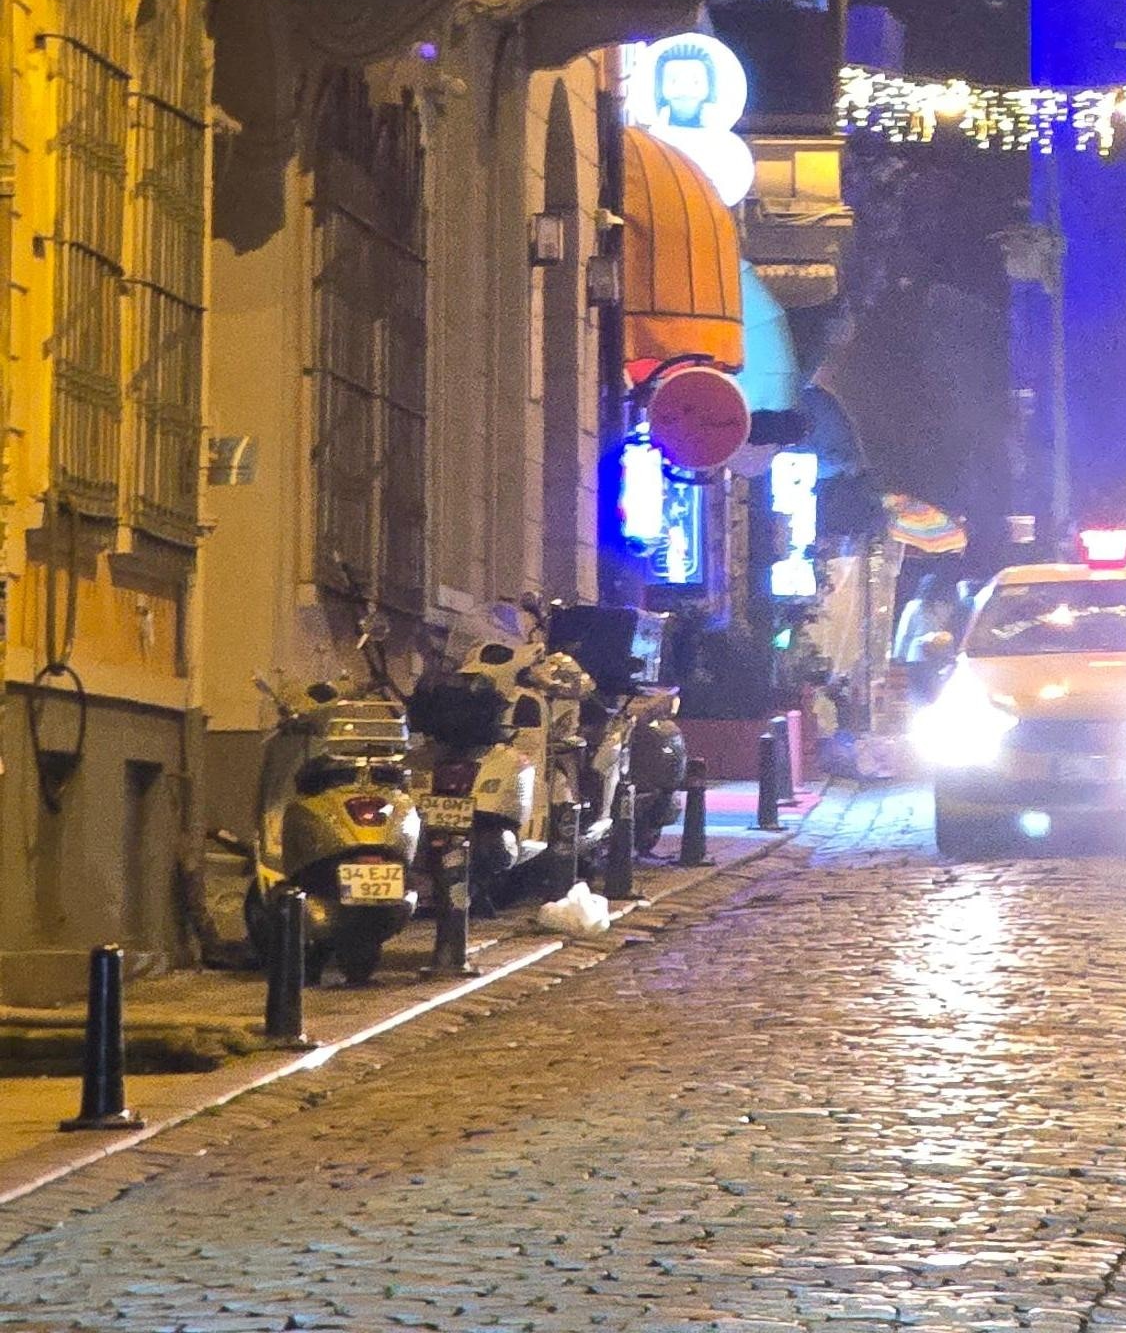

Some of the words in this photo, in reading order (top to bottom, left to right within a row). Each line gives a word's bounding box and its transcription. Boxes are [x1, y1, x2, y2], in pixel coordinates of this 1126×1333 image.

[342, 867, 363, 881] 34
[369, 867, 401, 881] EJZ
[360, 882, 391, 896] 927
